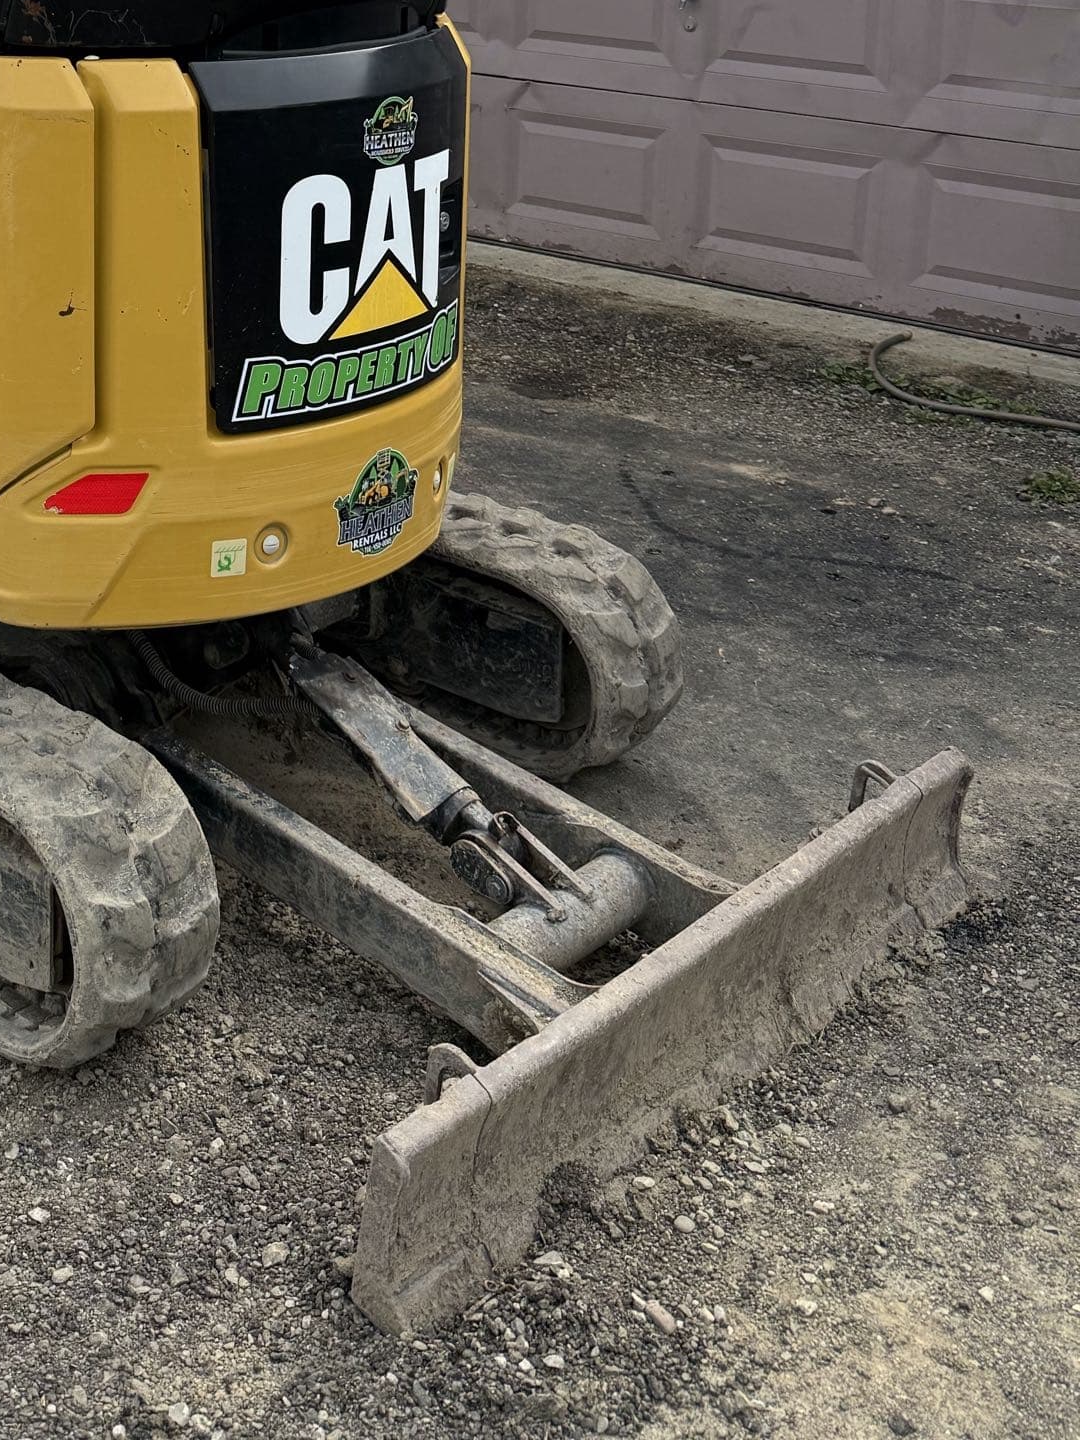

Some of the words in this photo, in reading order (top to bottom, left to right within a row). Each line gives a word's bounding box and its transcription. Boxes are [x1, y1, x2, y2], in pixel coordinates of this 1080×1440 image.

[365, 130, 415, 150] HEATHEN
[279, 148, 450, 345] CAT
[241, 331, 429, 415] PROPERTY
[430, 304, 458, 368] OF
[340, 495, 413, 541] HEATHEN
[353, 528, 389, 549] RENTALS
[389, 521, 402, 536] LLC
